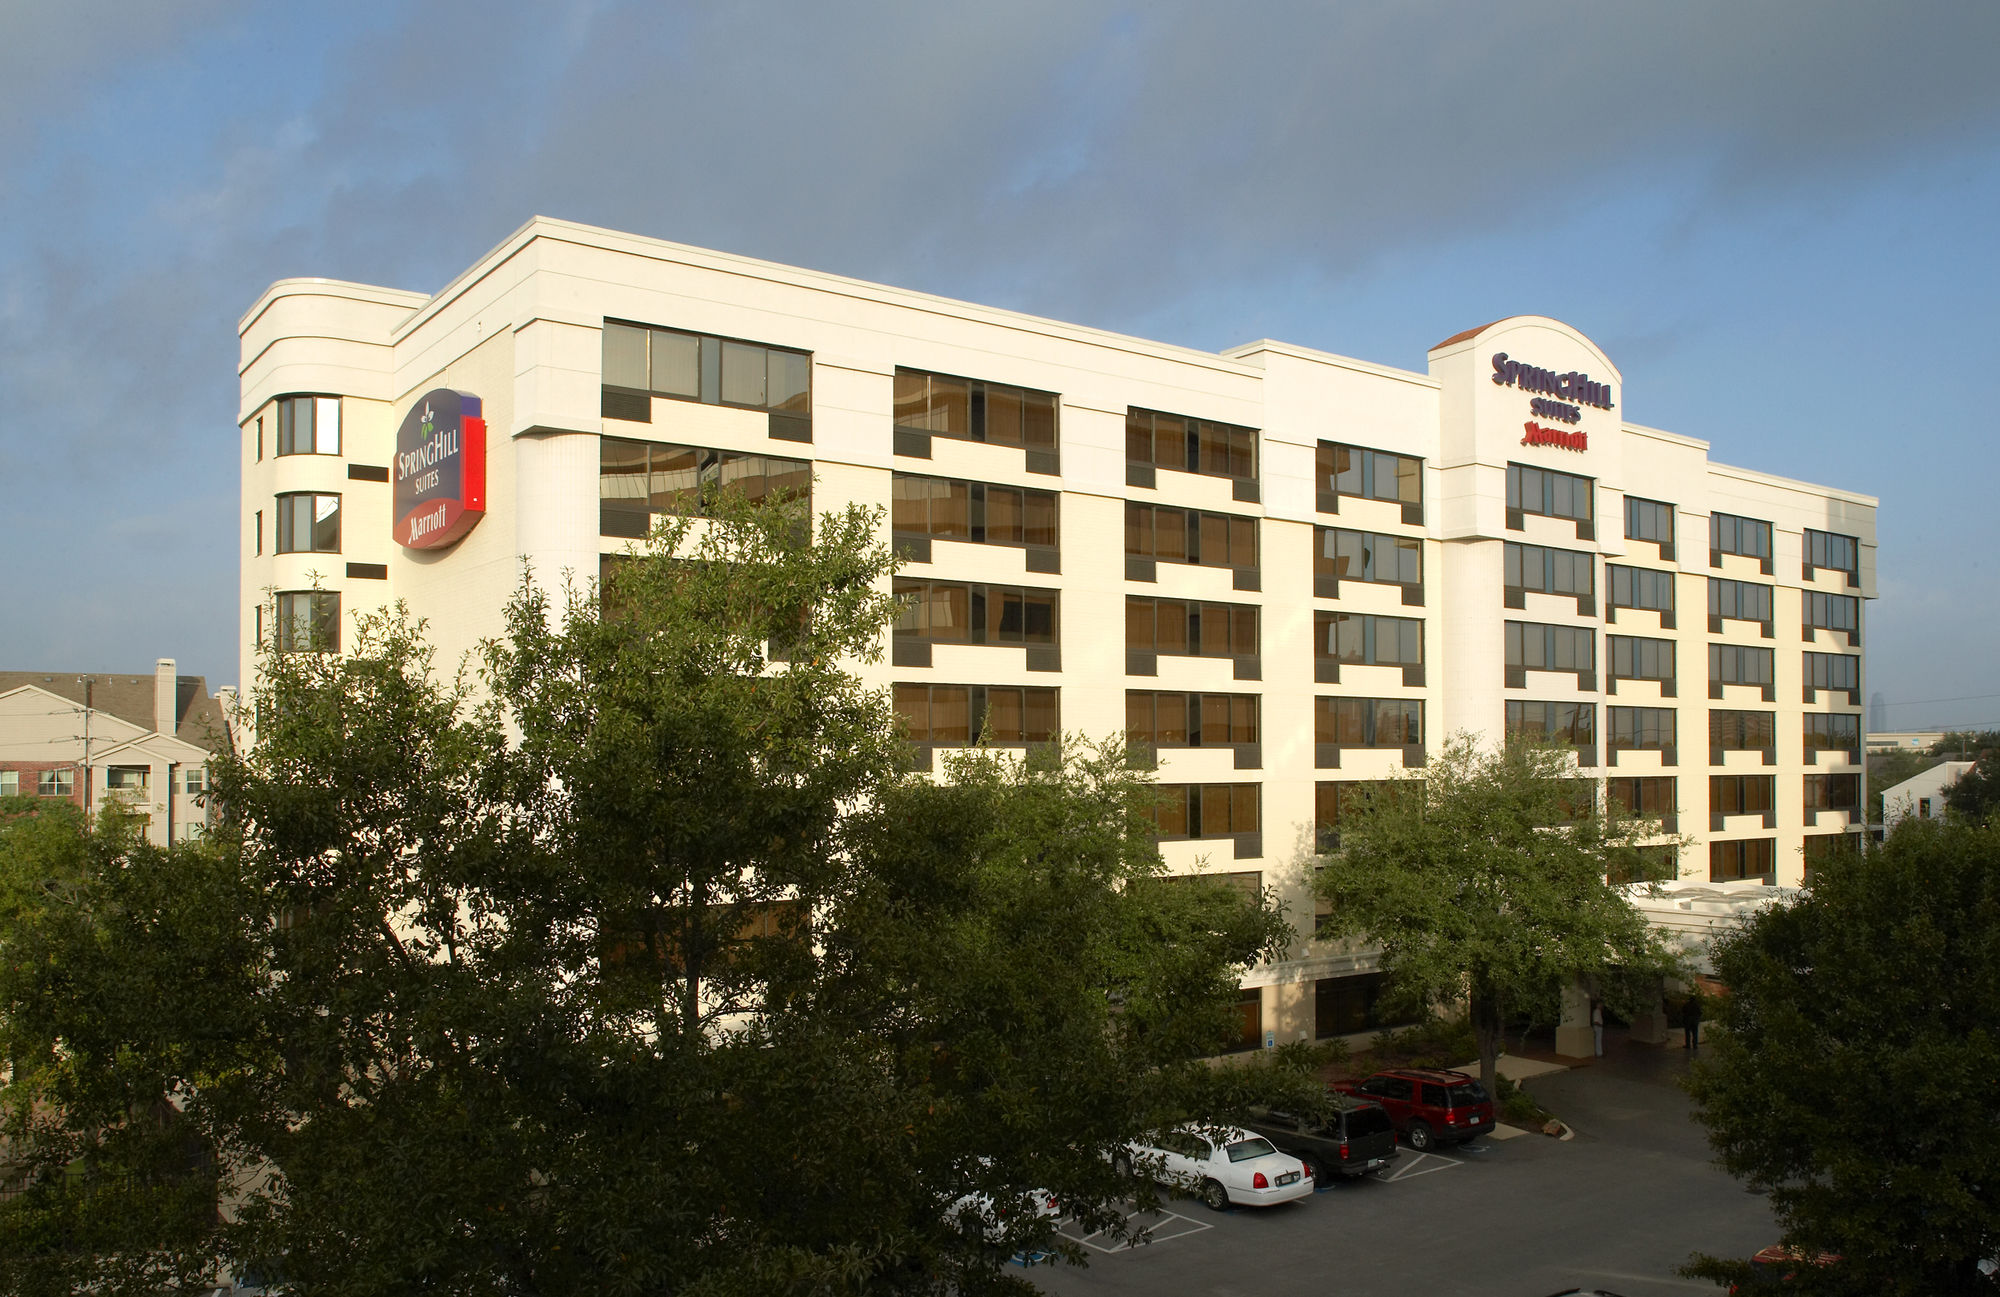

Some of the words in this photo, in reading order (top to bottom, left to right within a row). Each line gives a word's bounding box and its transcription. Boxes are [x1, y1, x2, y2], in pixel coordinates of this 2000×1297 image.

[1530, 397, 1582, 425] SUITES
[415, 468, 439, 495] SUITES
[408, 503, 446, 544] Marriott
